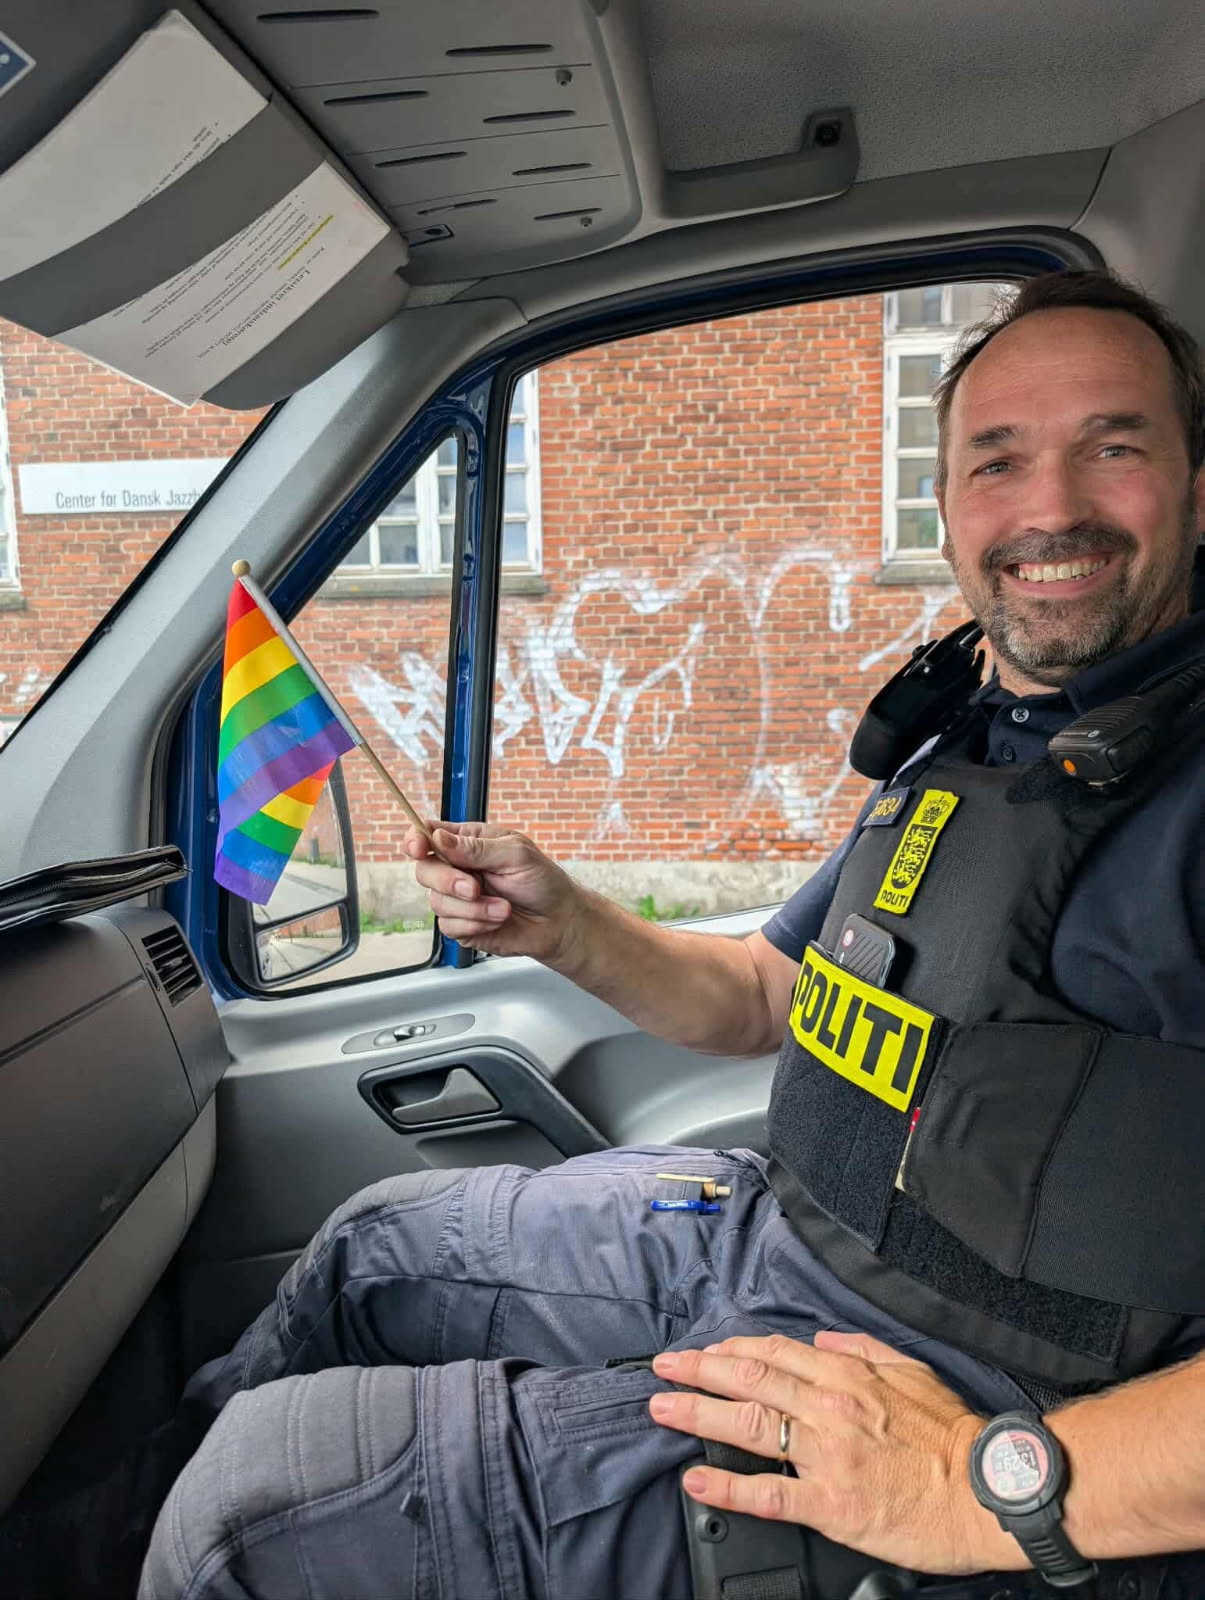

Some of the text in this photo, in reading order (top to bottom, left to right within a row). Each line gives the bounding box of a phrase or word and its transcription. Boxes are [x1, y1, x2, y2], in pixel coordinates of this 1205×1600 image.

[56, 490, 95, 509] Center
[101, 490, 117, 507] for
[122, 489, 161, 507] Dansk
[881, 890, 909, 907] POLITI
[799, 960, 924, 1095] POLITI
